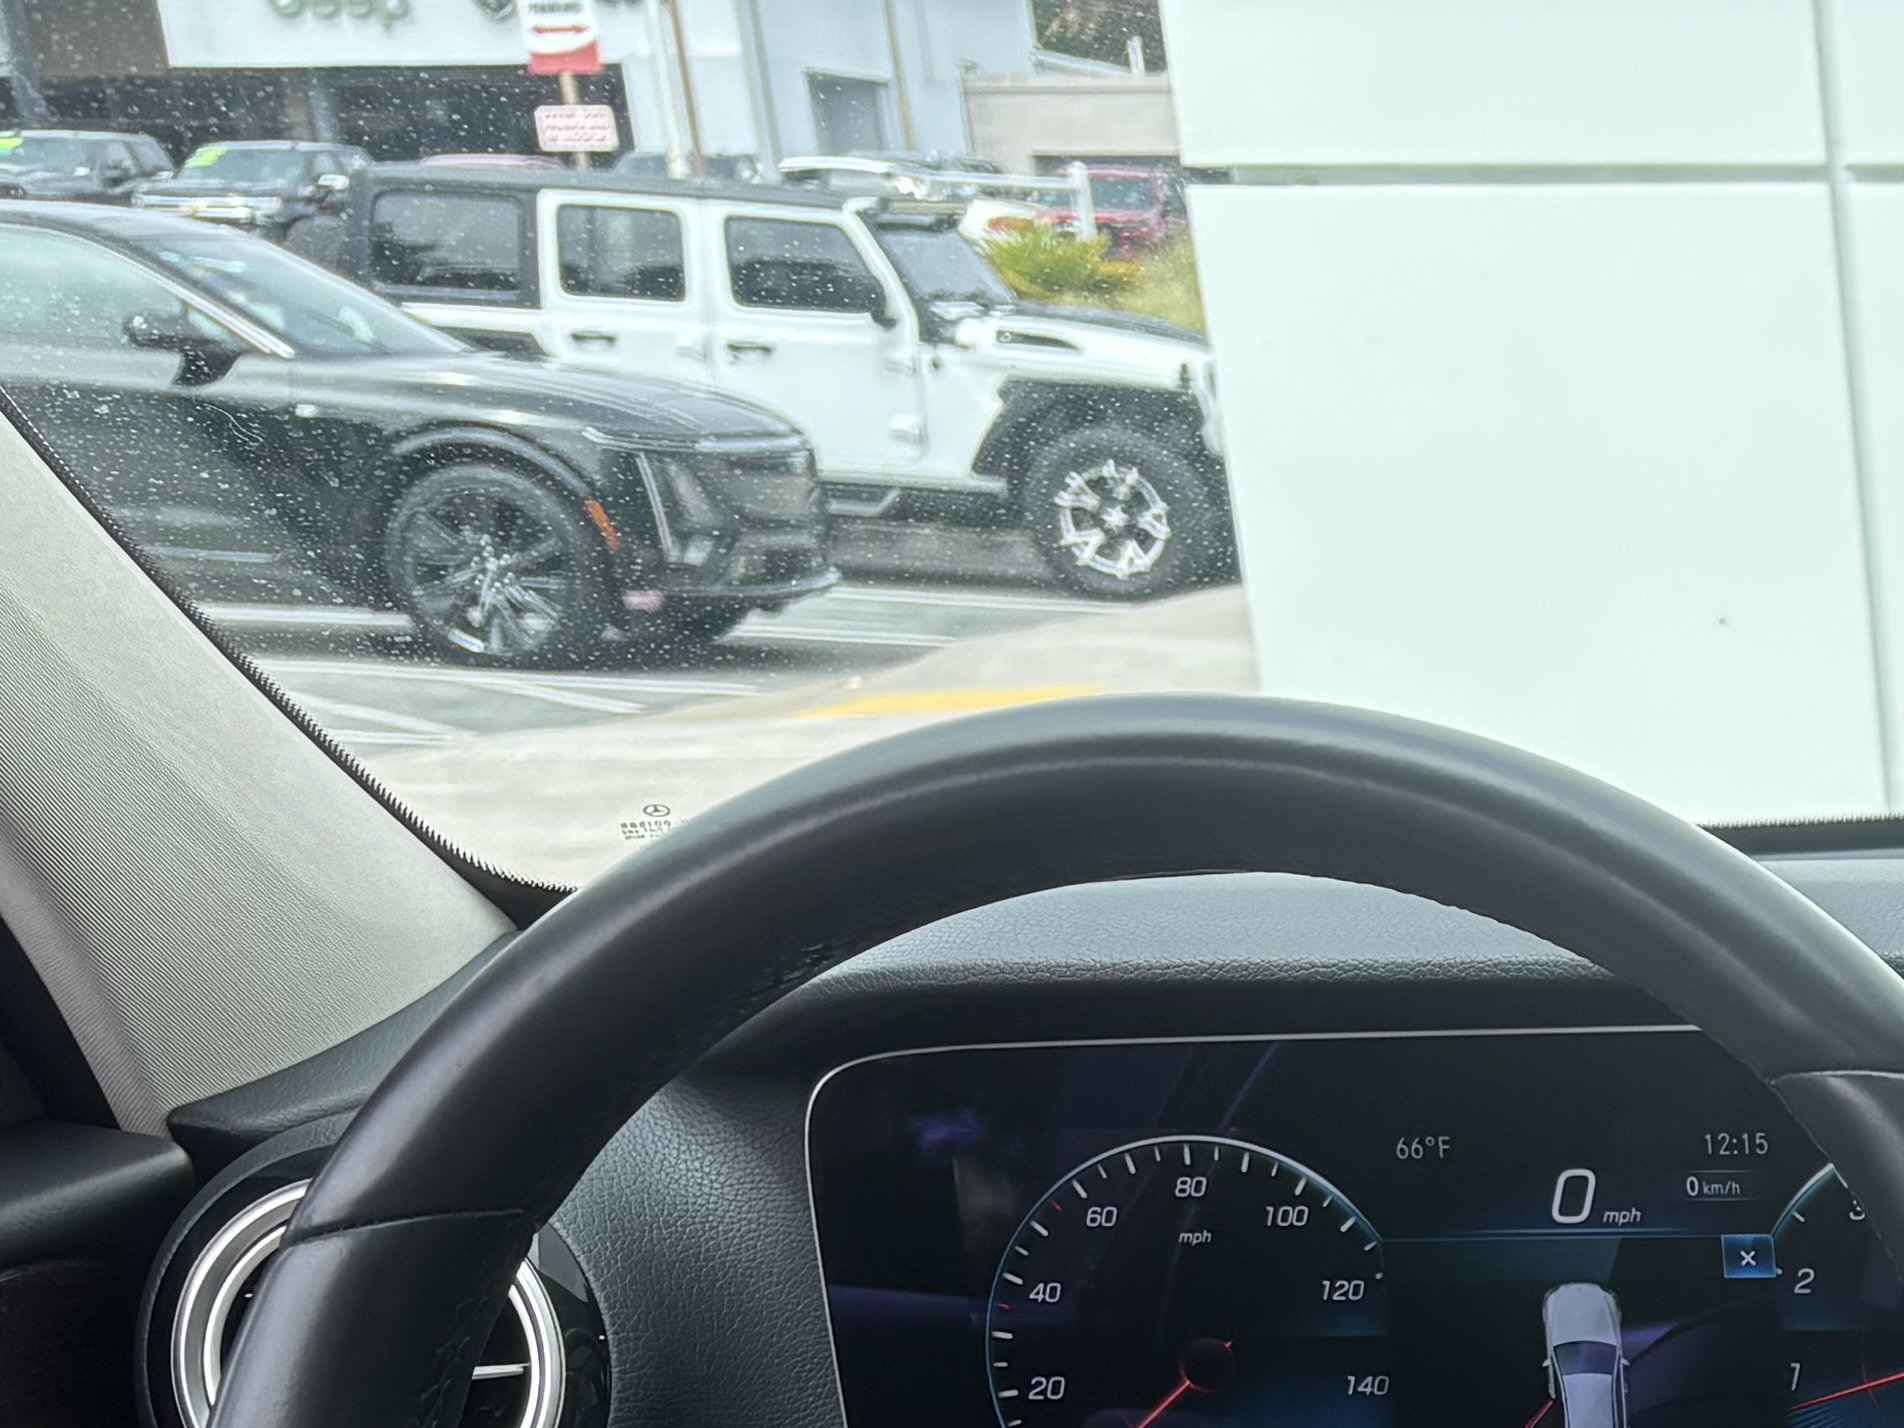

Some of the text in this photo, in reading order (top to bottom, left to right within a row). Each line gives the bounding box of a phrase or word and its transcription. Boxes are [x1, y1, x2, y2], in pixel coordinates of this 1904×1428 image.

[1396, 1135, 1450, 1160] 66°F
[1704, 1132, 1768, 1155] 12:15
[1174, 1177, 1207, 1198] 80
[1686, 1176, 1741, 1196] 0 km/h
[1551, 1168, 1642, 1227] 0 mph
[1085, 1207, 1118, 1227] 60
[1264, 1205, 1309, 1227] 100
[1178, 1229, 1212, 1246] mph
[1321, 1280, 1365, 1301] 120
[1793, 1267, 1816, 1294] 2
[1029, 1282, 1062, 1303] 40
[1346, 1375, 1390, 1396] 140
[1789, 1362, 1801, 1392] 1
[1027, 1377, 1066, 1401] 20
